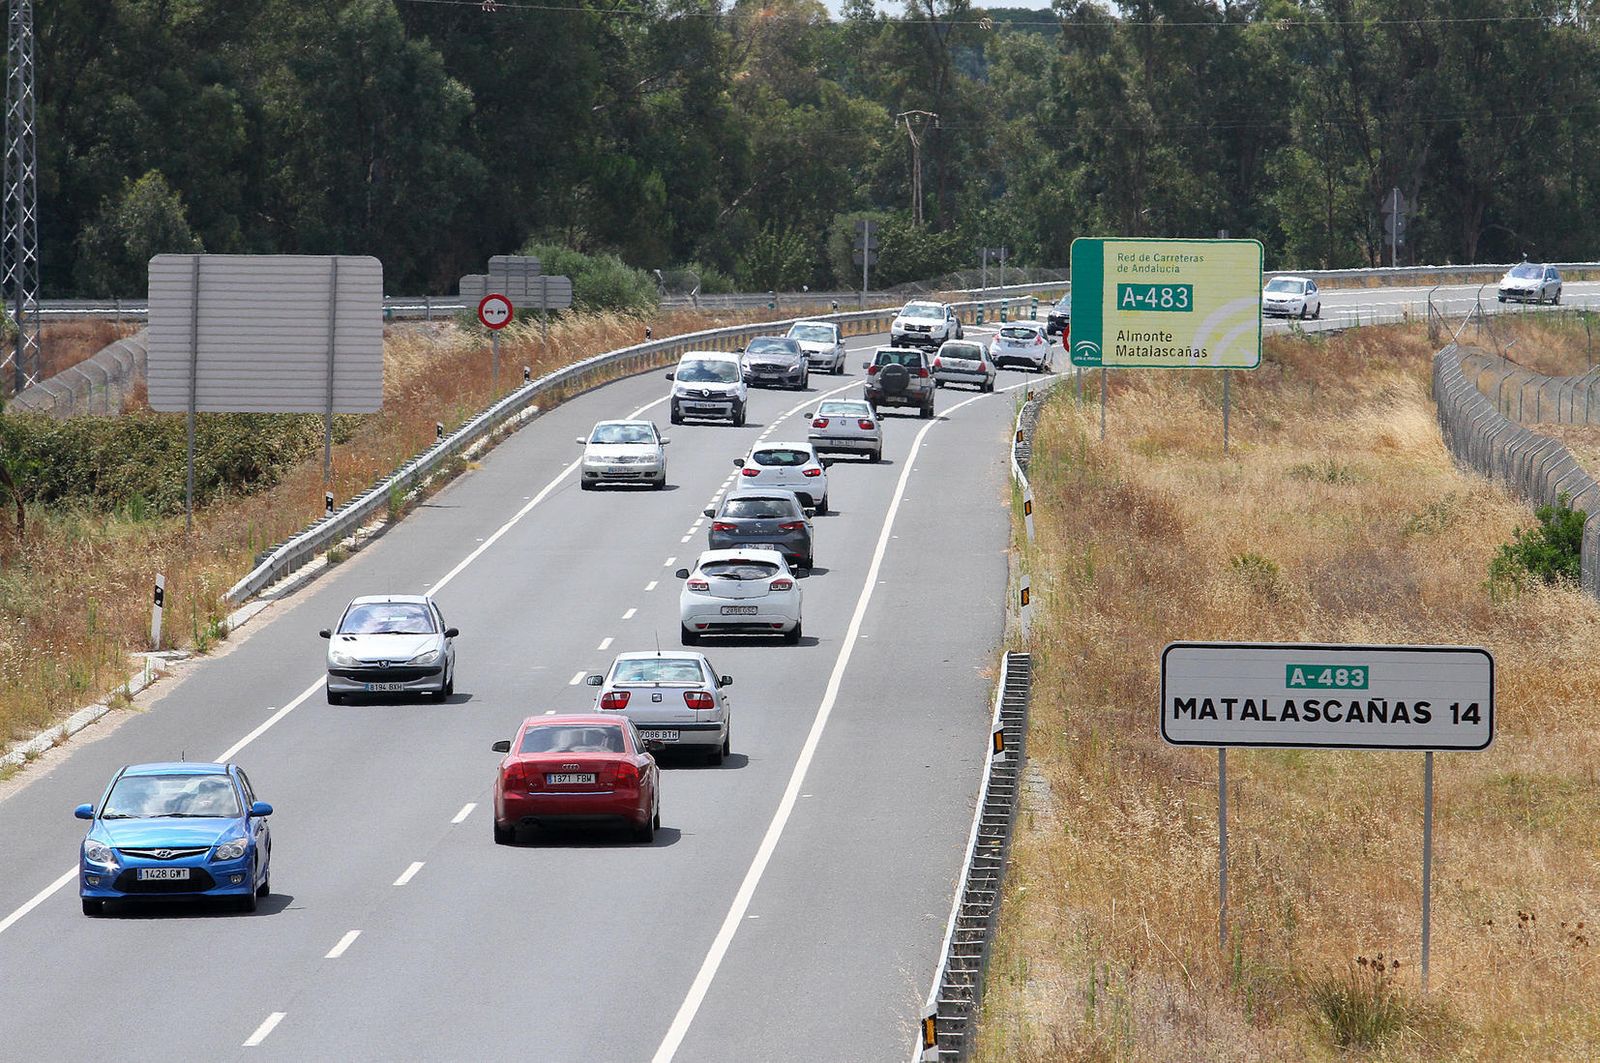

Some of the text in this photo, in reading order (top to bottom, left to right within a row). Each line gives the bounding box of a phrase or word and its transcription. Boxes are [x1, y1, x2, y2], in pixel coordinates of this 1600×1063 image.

[1117, 253, 1204, 263] Red de Carreteras
[1117, 264, 1128, 273] de
[1122, 286, 1189, 309] A-483
[1116, 330, 1173, 343] Almonte
[1116, 345, 1208, 358] Matalascañas
[1290, 667, 1365, 687] A-483
[1173, 697, 1481, 725] MATALASCAÑAS 14
[640, 730, 678, 738] 7086 BTH
[145, 869, 187, 879] 1428 GWT
